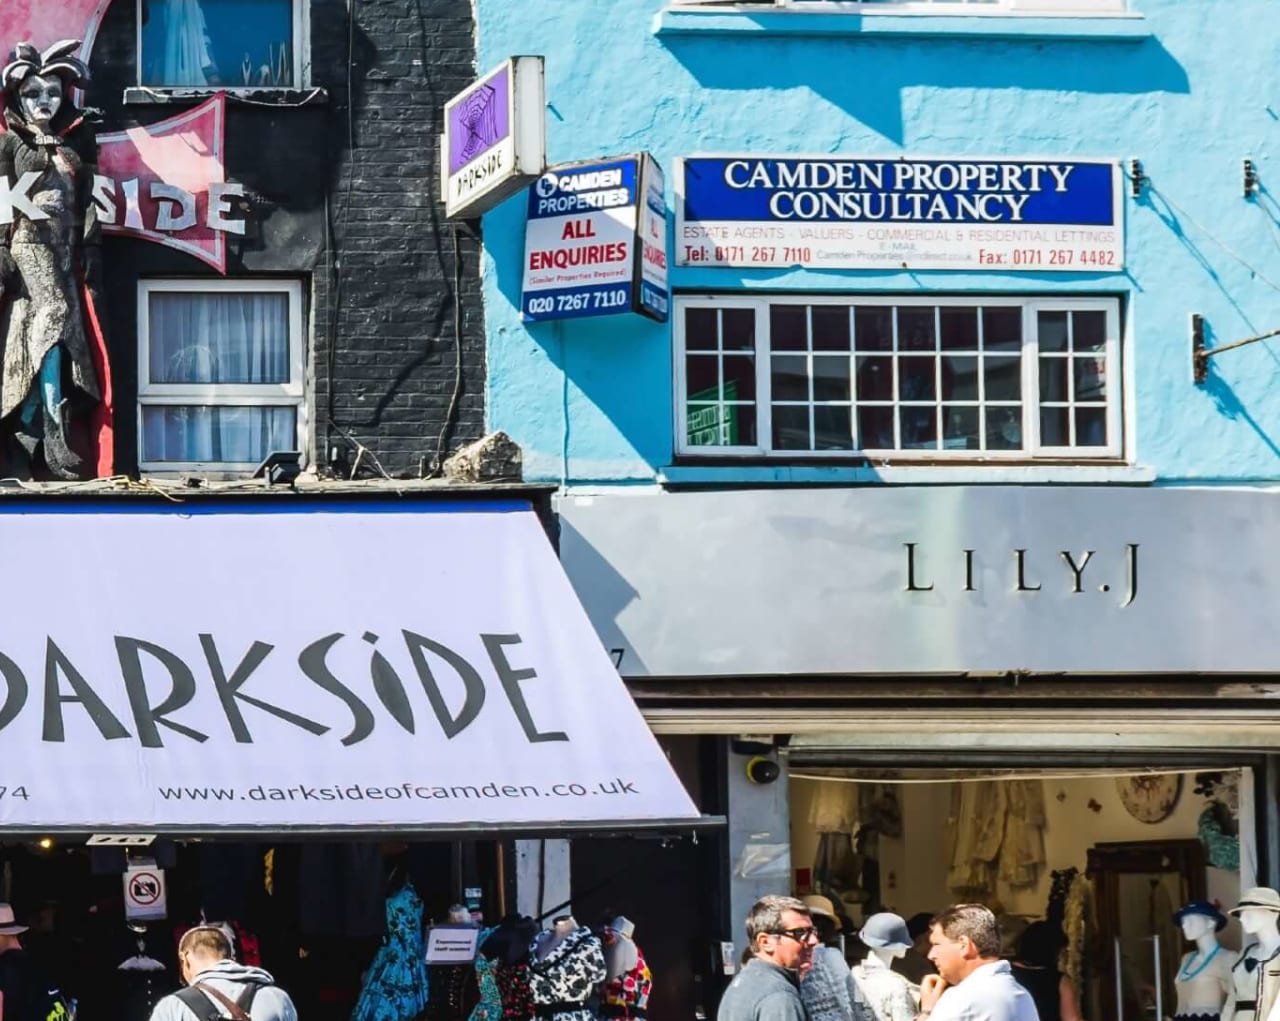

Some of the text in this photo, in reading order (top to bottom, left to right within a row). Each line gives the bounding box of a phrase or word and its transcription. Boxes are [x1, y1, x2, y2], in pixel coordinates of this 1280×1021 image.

[558, 169, 623, 192] CAMDEN
[724, 161, 1074, 192] CAMDEN PROPERTY
[90, 174, 247, 235] SIDE
[538, 187, 629, 215] PROPERTIES
[769, 191, 1030, 222] CONSULTANCY
[561, 218, 596, 241] ALL
[683, 226, 728, 239] ESTATE
[734, 226, 785, 240] AGENTS
[799, 228, 854, 240] VALUERS
[867, 228, 952, 242] COMMERCIAL
[969, 230, 1049, 242] RESIDENTIAL
[1055, 230, 1115, 242] LETTINGS
[529, 242, 627, 271] ENQUIRIES
[685, 246, 709, 262] Tel:
[715, 246, 744, 262] 0171
[752, 247, 776, 262] 267
[784, 247, 811, 263] 7110
[979, 249, 1115, 266] Fax: 0171 267 4482
[528, 296, 554, 314] 020
[557, 293, 590, 312] 7267
[594, 289, 627, 308] 7110
[158, 778, 640, 802] www.darksideofcamden.co.uk
